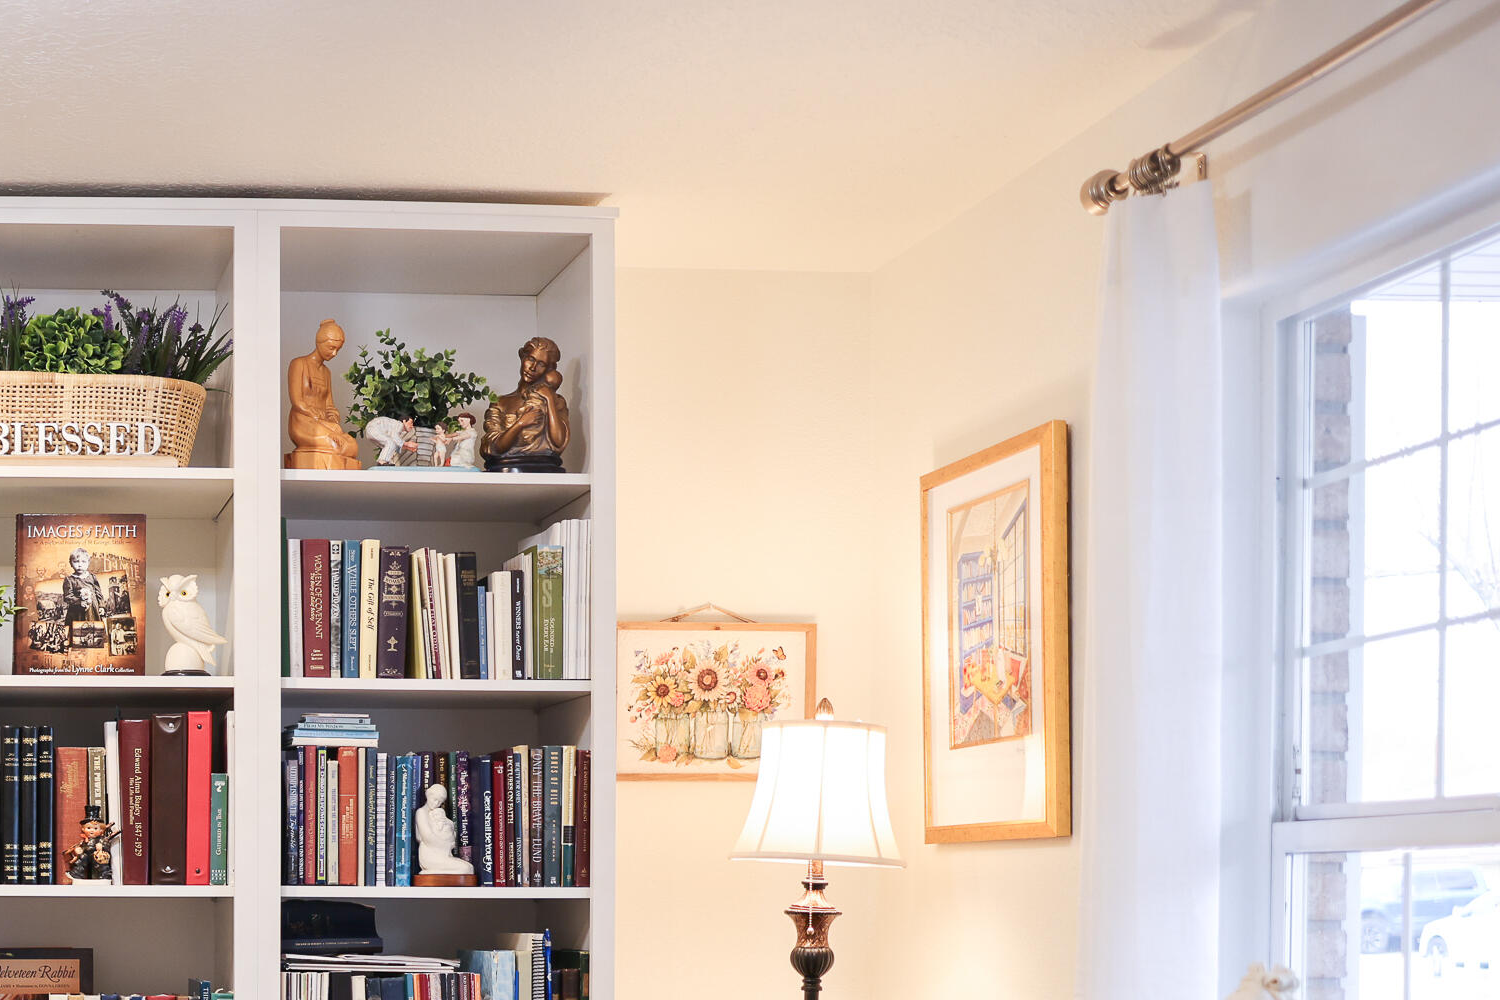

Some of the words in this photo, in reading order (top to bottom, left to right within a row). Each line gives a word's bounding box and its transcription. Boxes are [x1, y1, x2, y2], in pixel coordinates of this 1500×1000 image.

[28, 526, 83, 538] IMAGES
[84, 526, 93, 538] of
[94, 525, 137, 538] FAITH
[314, 554, 322, 586] WOMEN
[348, 564, 357, 593] WHILE
[314, 586, 322, 598] OF
[314, 598, 322, 640] COVENANT
[72, 665, 93, 675] Lynne
[94, 664, 114, 673] Clark
[532, 753, 542, 776] ONLY
[507, 791, 514, 801] ON
[532, 780, 542, 797] THE
[483, 790, 492, 811] Great
[483, 812, 492, 832] Shall
[532, 800, 542, 828] BRAVE
[483, 832, 492, 843] Be
[483, 843, 492, 860] Your
[532, 838, 542, 863] LUND
[483, 861, 492, 873] Joy
[39, 965, 76, 983] Rabbit
